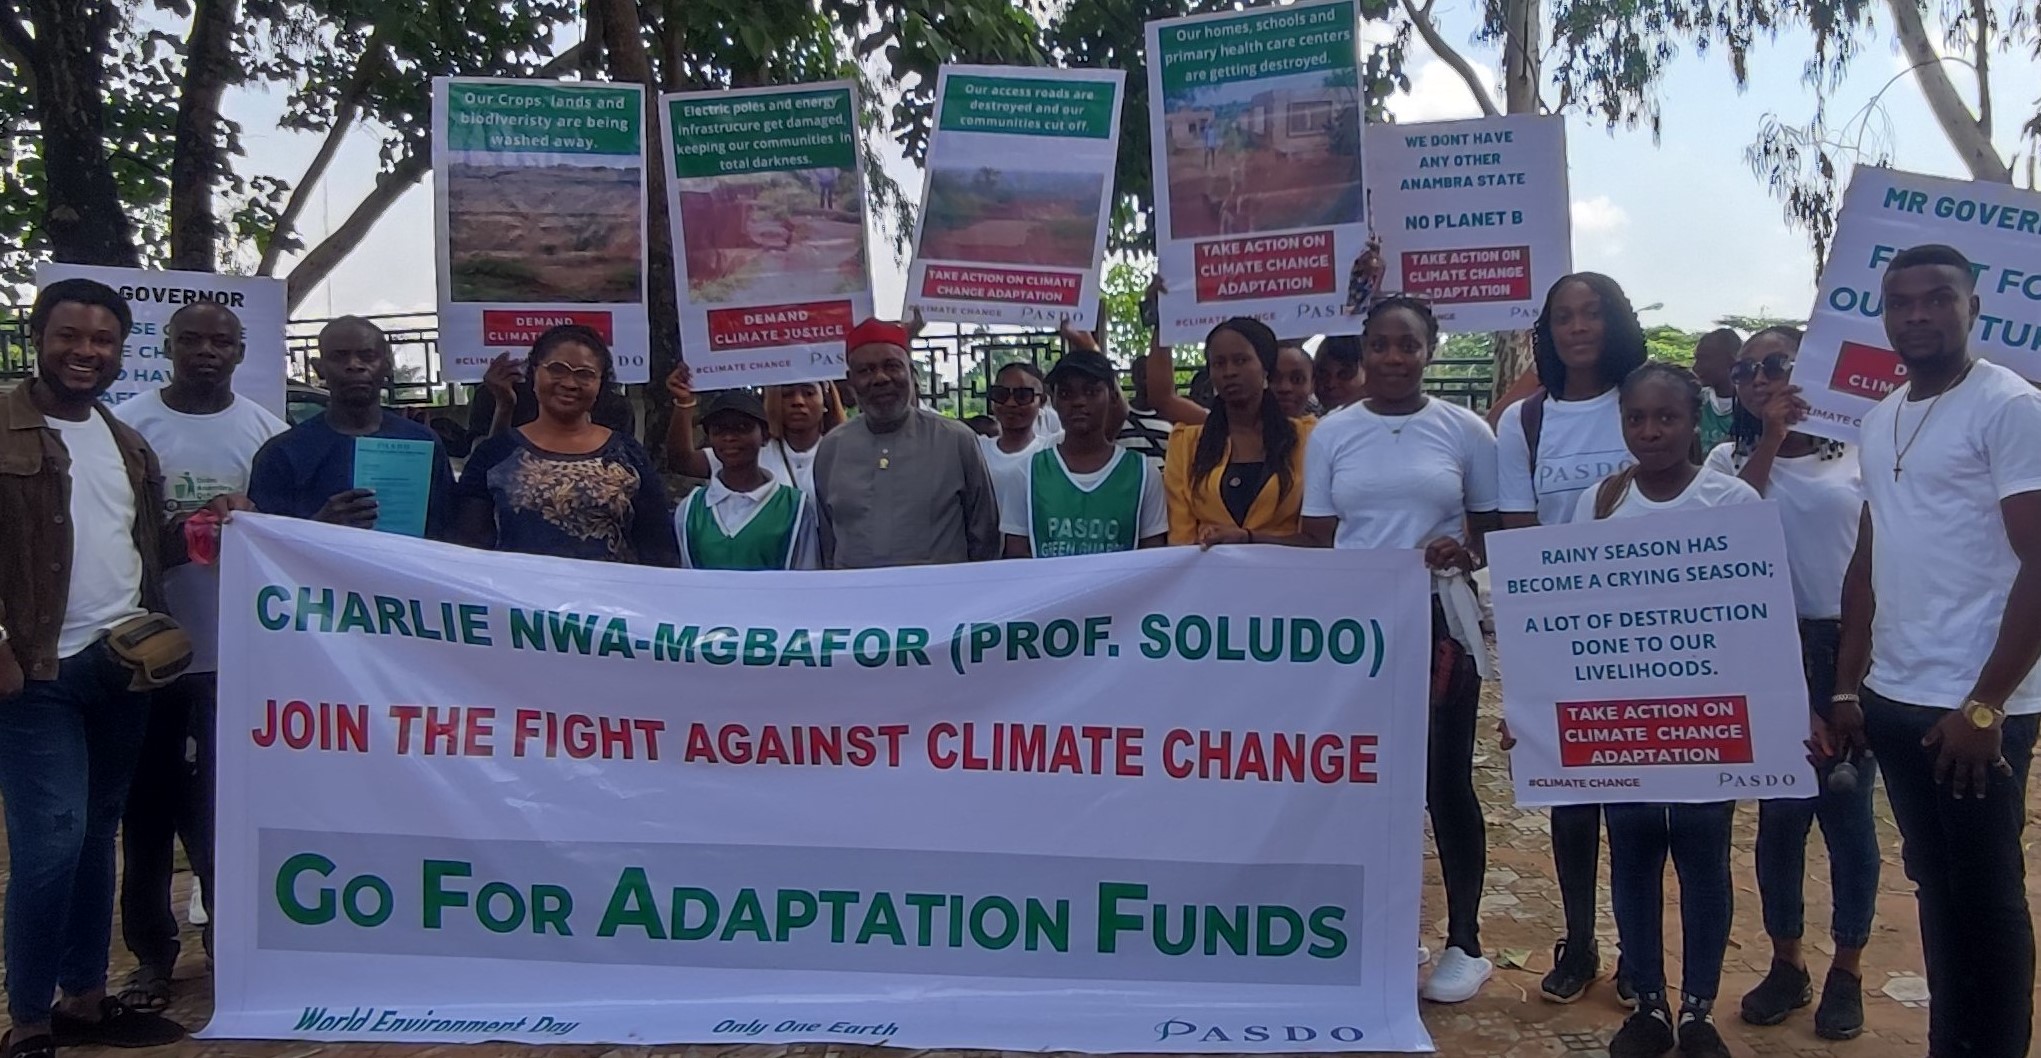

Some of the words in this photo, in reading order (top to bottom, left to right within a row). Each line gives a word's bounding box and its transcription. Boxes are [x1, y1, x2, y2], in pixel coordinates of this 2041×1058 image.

[1177, 29, 1200, 41] Our
[1205, 22, 1252, 38] homes,
[1256, 14, 1306, 31] schools
[1310, 8, 1336, 22] and
[1165, 47, 1217, 66] primary
[1221, 40, 1263, 56] health
[1267, 37, 1295, 50] care
[1300, 30, 1350, 45] centers
[1185, 70, 1206, 82] are
[1210, 62, 1256, 82] getting
[1260, 52, 1331, 72] destroyed.
[465, 93, 492, 104] Our
[552, 95, 591, 108] lands
[597, 97, 624, 108] and
[965, 84, 987, 94] Our
[992, 86, 1031, 97] access
[1035, 88, 1069, 99] roads
[1074, 90, 1094, 100] are
[684, 103, 730, 116] Electric
[733, 101, 765, 116] poles
[769, 98, 792, 110] and
[795, 96, 838, 110] energy
[970, 100, 1032, 114] destroyed
[1036, 103, 1058, 114] and
[1062, 106, 1084, 115] our
[460, 112, 550, 129] biodiveristy
[557, 118, 581, 127] are
[587, 116, 628, 131] being
[678, 120, 760, 136] infrastrucure
[764, 119, 783, 132] get
[960, 116, 1040, 129] communities
[1045, 119, 1064, 130] cut
[491, 133, 548, 146] washed
[554, 137, 597, 150] away.
[677, 138, 726, 155] keeping
[729, 140, 750, 150] our
[753, 134, 833, 149] communities
[1406, 136, 1427, 148] WE
[1431, 134, 1469, 146] DONT
[1473, 131, 1513, 144] HAVE
[720, 156, 750, 170] total
[753, 155, 813, 168] darkness.
[1420, 156, 1449, 168] ANY
[1454, 153, 1500, 167] OTHER
[1401, 176, 1473, 190] ANAMBRA
[1478, 173, 1525, 186] STATE
[1406, 215, 1429, 230] NO
[1435, 211, 1506, 228] PLANET
[1512, 211, 1523, 225] B
[1884, 187, 1928, 214] MR
[1934, 196, 2041, 236] GOVER
[1203, 243, 1240, 257] TAKE
[1244, 237, 1299, 253] ACTION
[1303, 235, 1325, 248] ON
[1201, 261, 1263, 277] CLIMATE
[1266, 255, 1329, 271] CHANGE
[1411, 253, 1446, 265] TAKE
[1451, 251, 1499, 264] ACTION
[1502, 250, 1520, 261] ON
[929, 270, 958, 281] TAKE
[961, 271, 1003, 283] ACTION
[1007, 275, 1023, 284] ON
[1026, 276, 1075, 288] CLIMATE
[1409, 269, 1467, 282] CLIMATE
[1470, 267, 1524, 279] CHANGE
[937, 286, 984, 297] CHANGE
[987, 287, 1063, 302] ADAPTATION
[1217, 277, 1313, 296] ADAPTATION
[120, 285, 245, 308] GOVERNOR
[1829, 287, 1883, 317] OU
[744, 311, 808, 325] DEMAND
[960, 308, 1002, 317] CHANGE
[1298, 303, 1344, 318] PAS
[1510, 306, 1539, 318] PAS
[516, 317, 574, 327] DEMAND
[489, 332, 539, 341] CLIMAT
[715, 330, 778, 344] CLIMATE
[784, 325, 844, 339] JUSTICE
[696, 363, 745, 374] #CLIMATE
[750, 360, 791, 370] CHANGE
[809, 352, 844, 365] PAS
[1849, 374, 1895, 393] CLIM
[1048, 518, 1118, 540] PASDO
[1542, 547, 1599, 565] RAINY
[1604, 539, 1681, 560] SEASON
[1688, 536, 1728, 553] HAS
[1508, 575, 1583, 594] BECOME
[1589, 574, 1601, 588] A
[1607, 568, 1679, 587] CRYING
[1686, 561, 1774, 582] SEASON;
[1525, 618, 1538, 633] A
[1544, 615, 1580, 632] LOT
[1587, 613, 1613, 629] OF
[1620, 603, 1768, 628] DESTRUCTION
[256, 585, 493, 646] CHARLIE
[509, 607, 931, 668] NWA-MGBAFOR
[950, 616, 1120, 675] (PROF.
[1138, 613, 1385, 678] SOLUDO)
[1572, 638, 1629, 656] DONE
[1635, 636, 1662, 652] TO
[1670, 634, 1716, 650] OUR
[1576, 660, 1718, 681] LIVELIHOODS.
[1567, 707, 1618, 721] TAKE
[1624, 704, 1698, 719] ACTION
[1703, 702, 1733, 716] ON
[252, 699, 369, 753] JOIN
[389, 704, 496, 757] THE
[513, 708, 665, 761] FIGHT
[683, 722, 909, 768] AGAINST
[927, 722, 1144, 777] CLIMATE
[1162, 729, 1379, 784] CHANGE
[1564, 728, 1648, 743] CLIMATE
[1657, 725, 1743, 740] CHANGE
[1591, 749, 1719, 764] ADAPTATION
[1529, 778, 1586, 788] #CLIMATE
[1589, 777, 1640, 788] CHANGE
[1719, 772, 1795, 787] PASDO
[294, 1007, 375, 1031] World
[370, 1010, 528, 1033] Environment
[528, 1015, 579, 1036] Day
[713, 1019, 768, 1036] Only
[775, 1019, 822, 1033] One
[827, 1020, 900, 1036] Earth
[1155, 1016, 1364, 1042] PASDO
